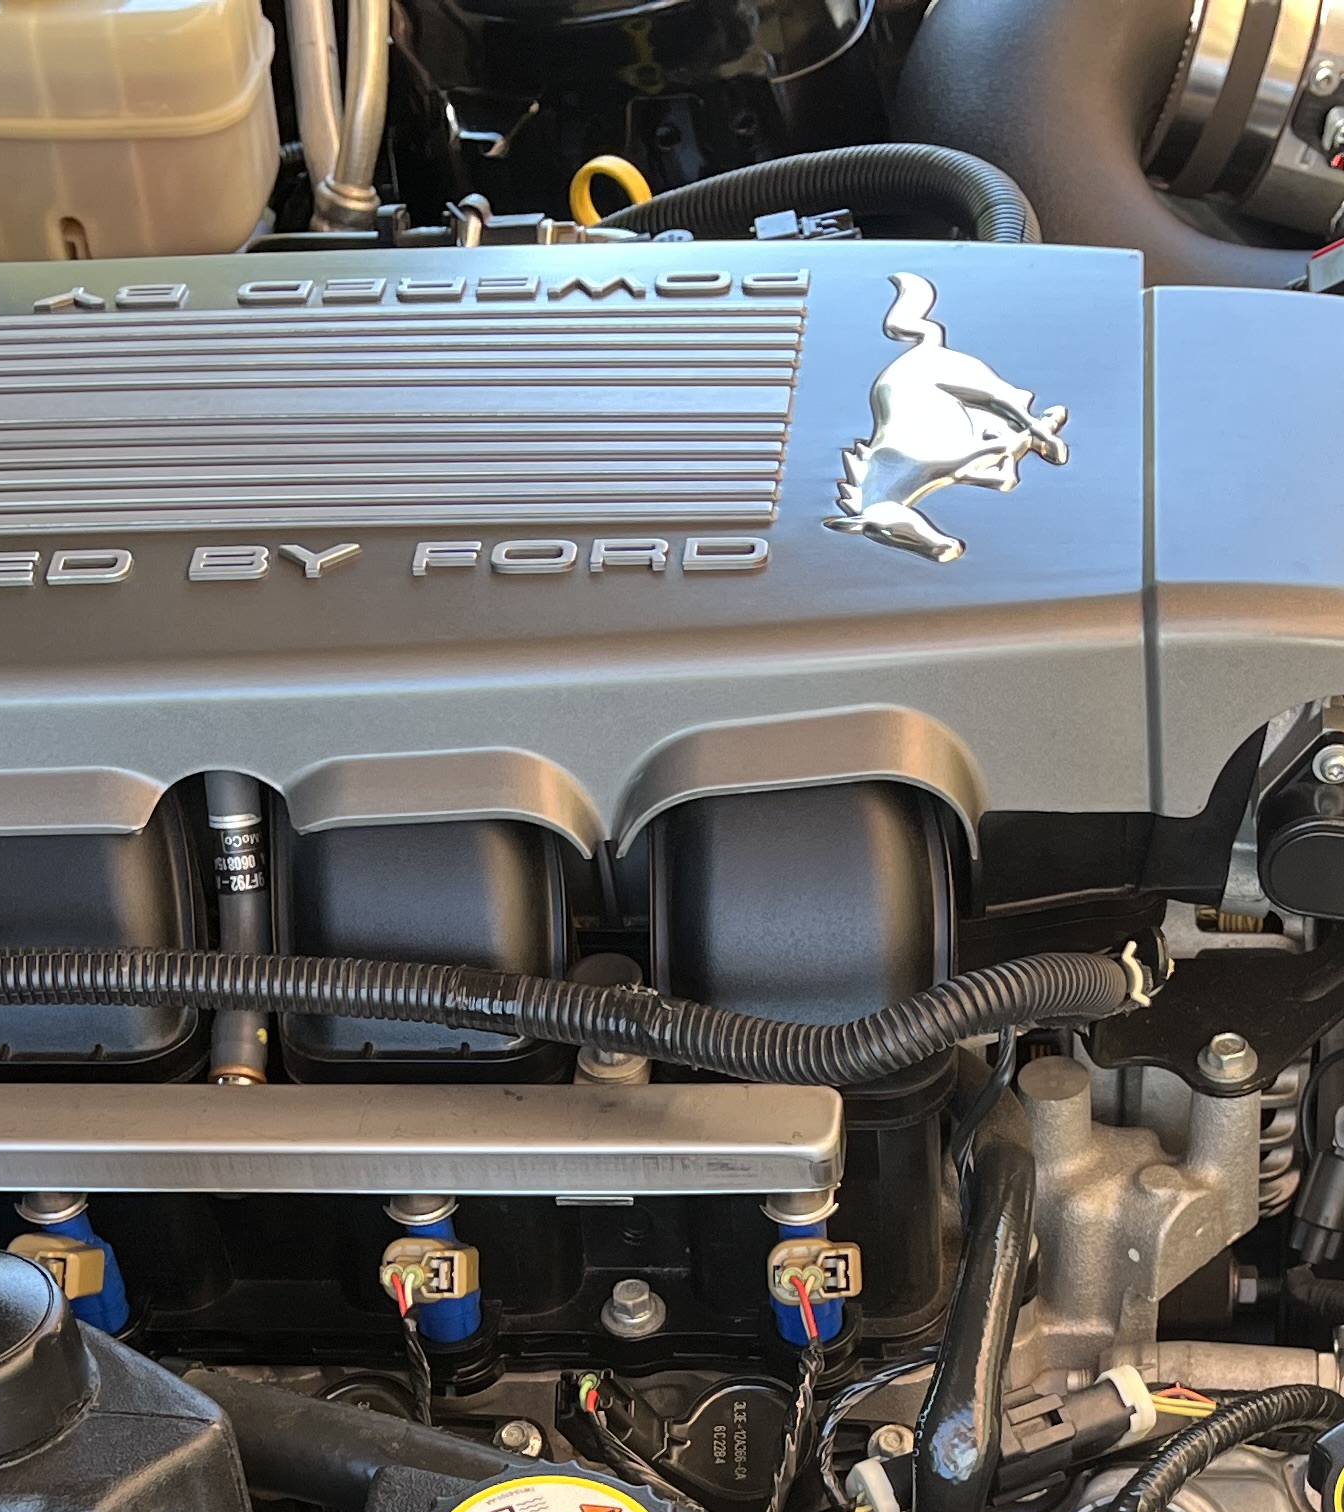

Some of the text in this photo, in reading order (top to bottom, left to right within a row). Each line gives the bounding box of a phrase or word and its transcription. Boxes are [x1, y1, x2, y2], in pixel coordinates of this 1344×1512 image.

[34, 284, 190, 311] BY
[236, 268, 812, 307] POWERED
[187, 543, 362, 582] BY
[412, 536, 770, 577] FORD
